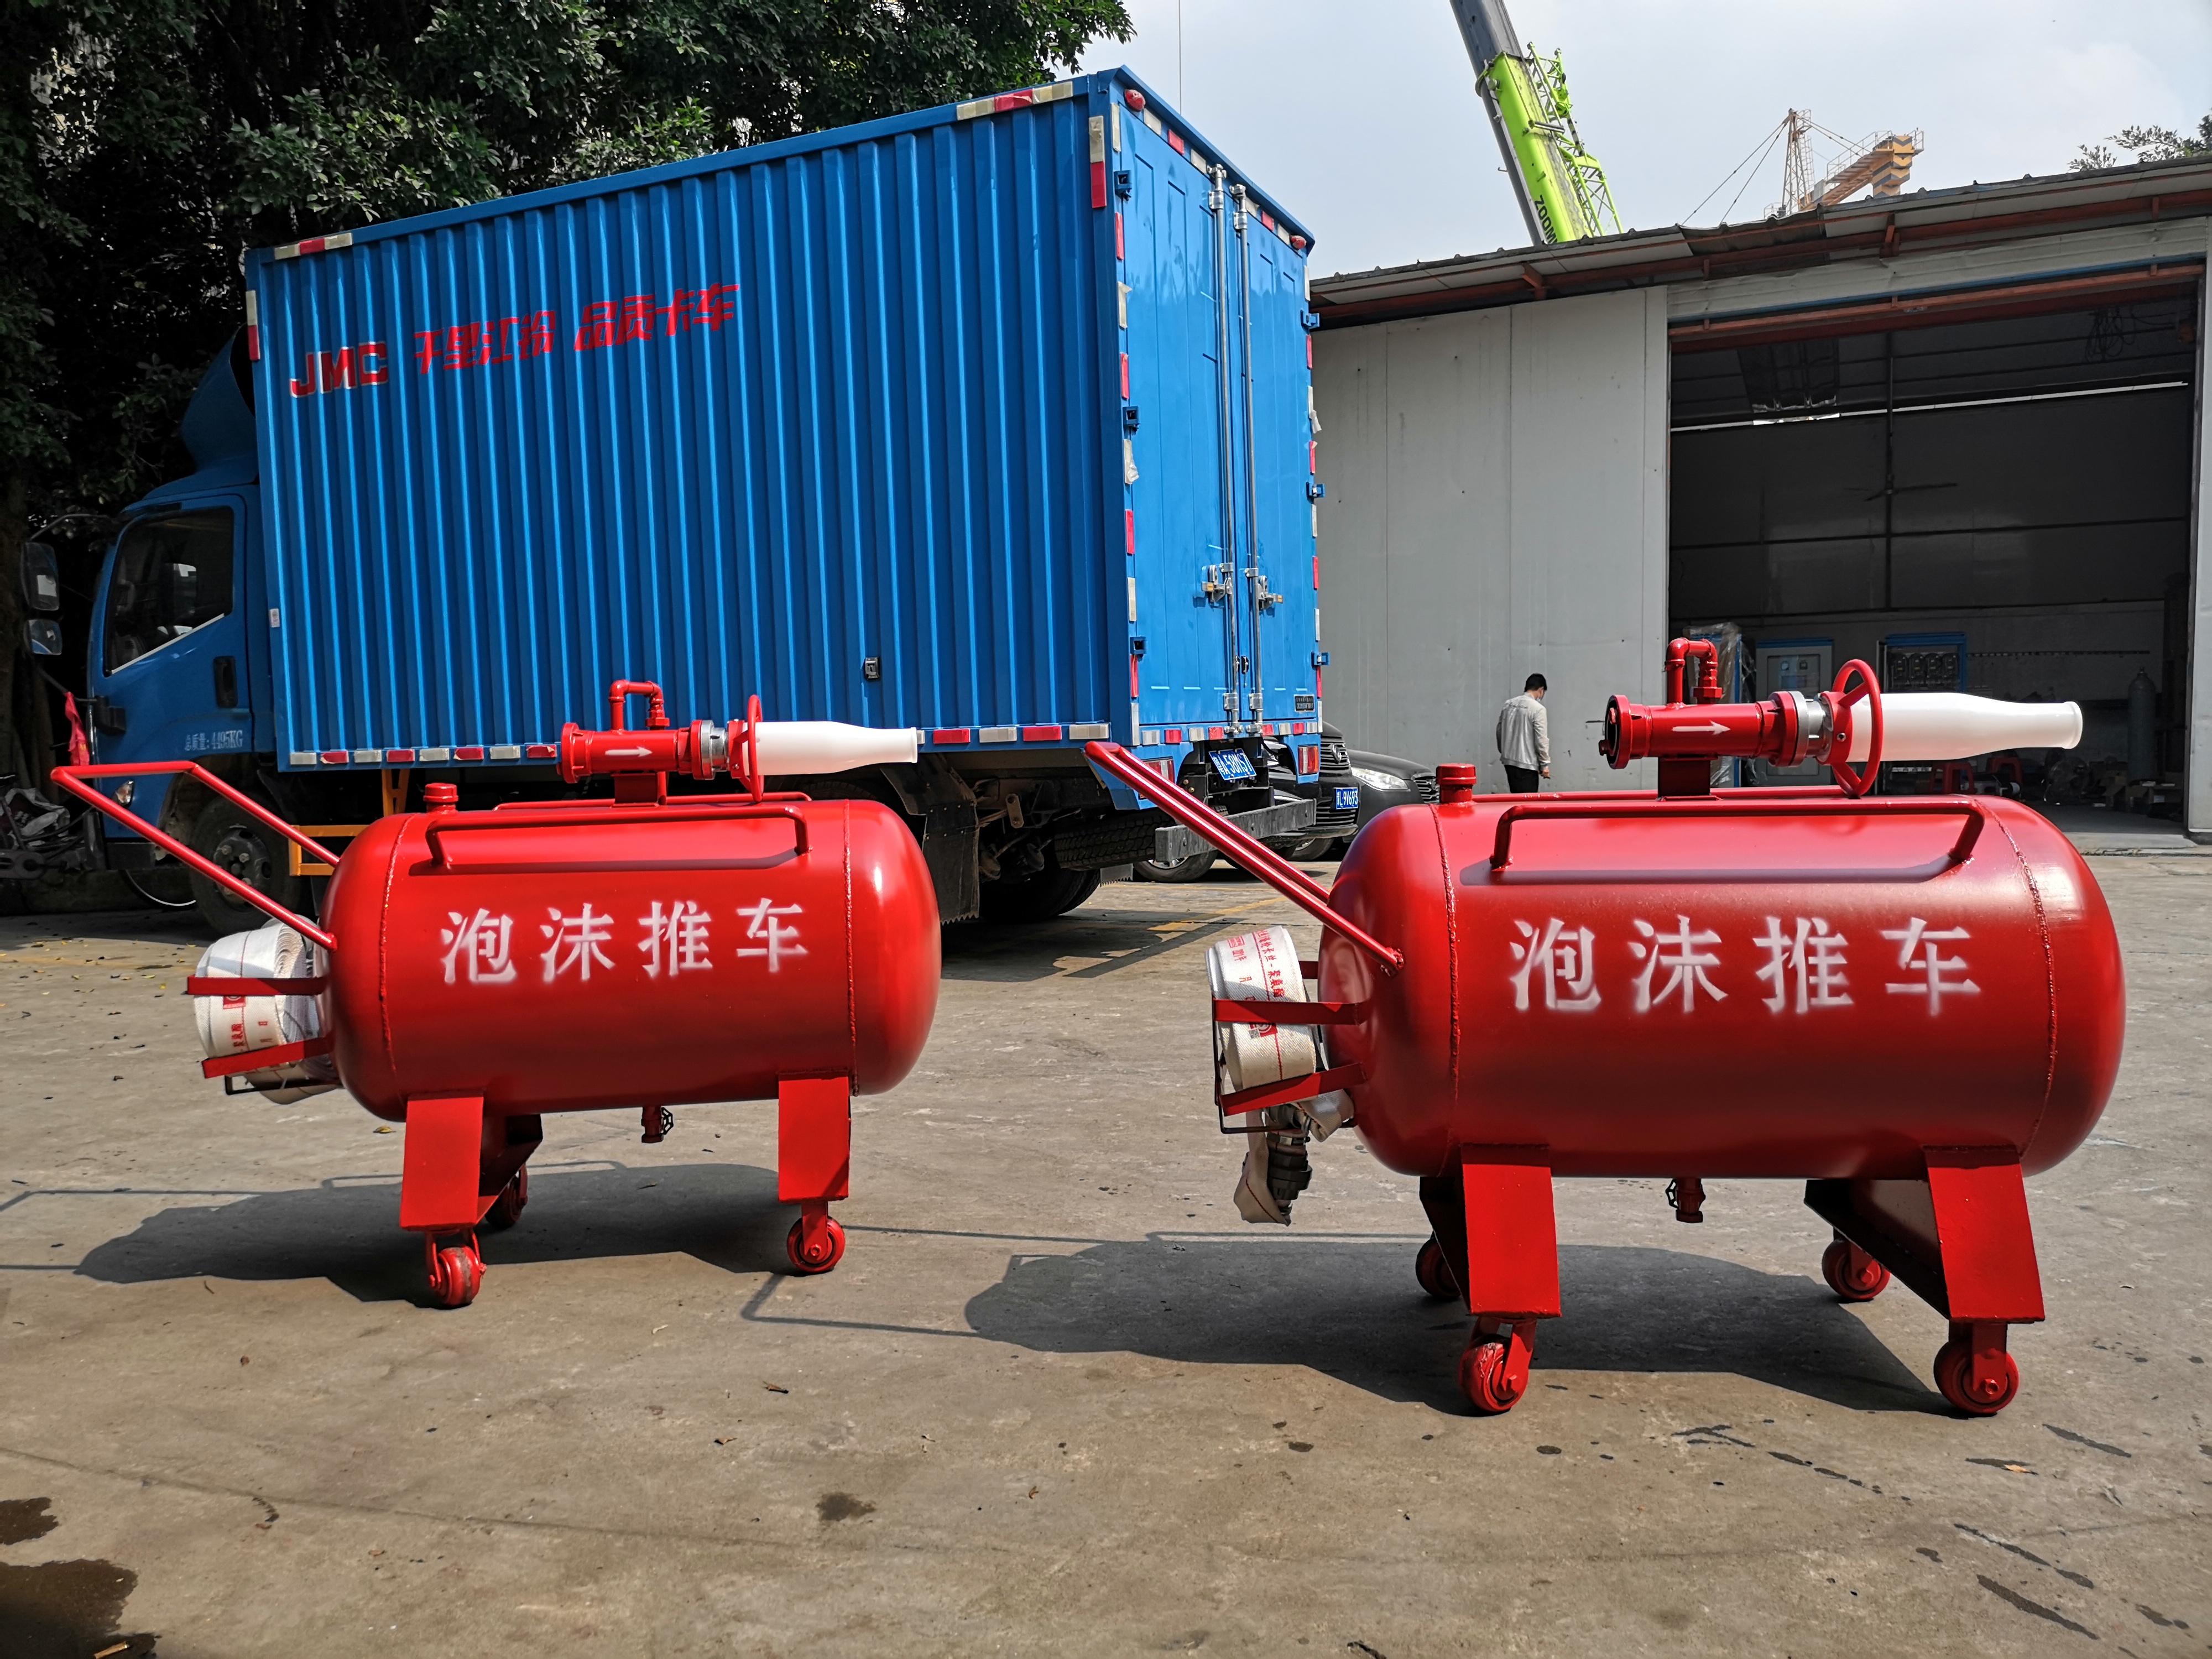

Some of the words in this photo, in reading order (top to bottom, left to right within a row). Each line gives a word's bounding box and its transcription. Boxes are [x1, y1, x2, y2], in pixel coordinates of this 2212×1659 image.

[290, 341, 388, 398] JMC
[573, 283, 740, 352] 品质卡车
[440, 897, 809, 984] 泡沫推车
[1509, 914, 1982, 1016] 泡沫推车
